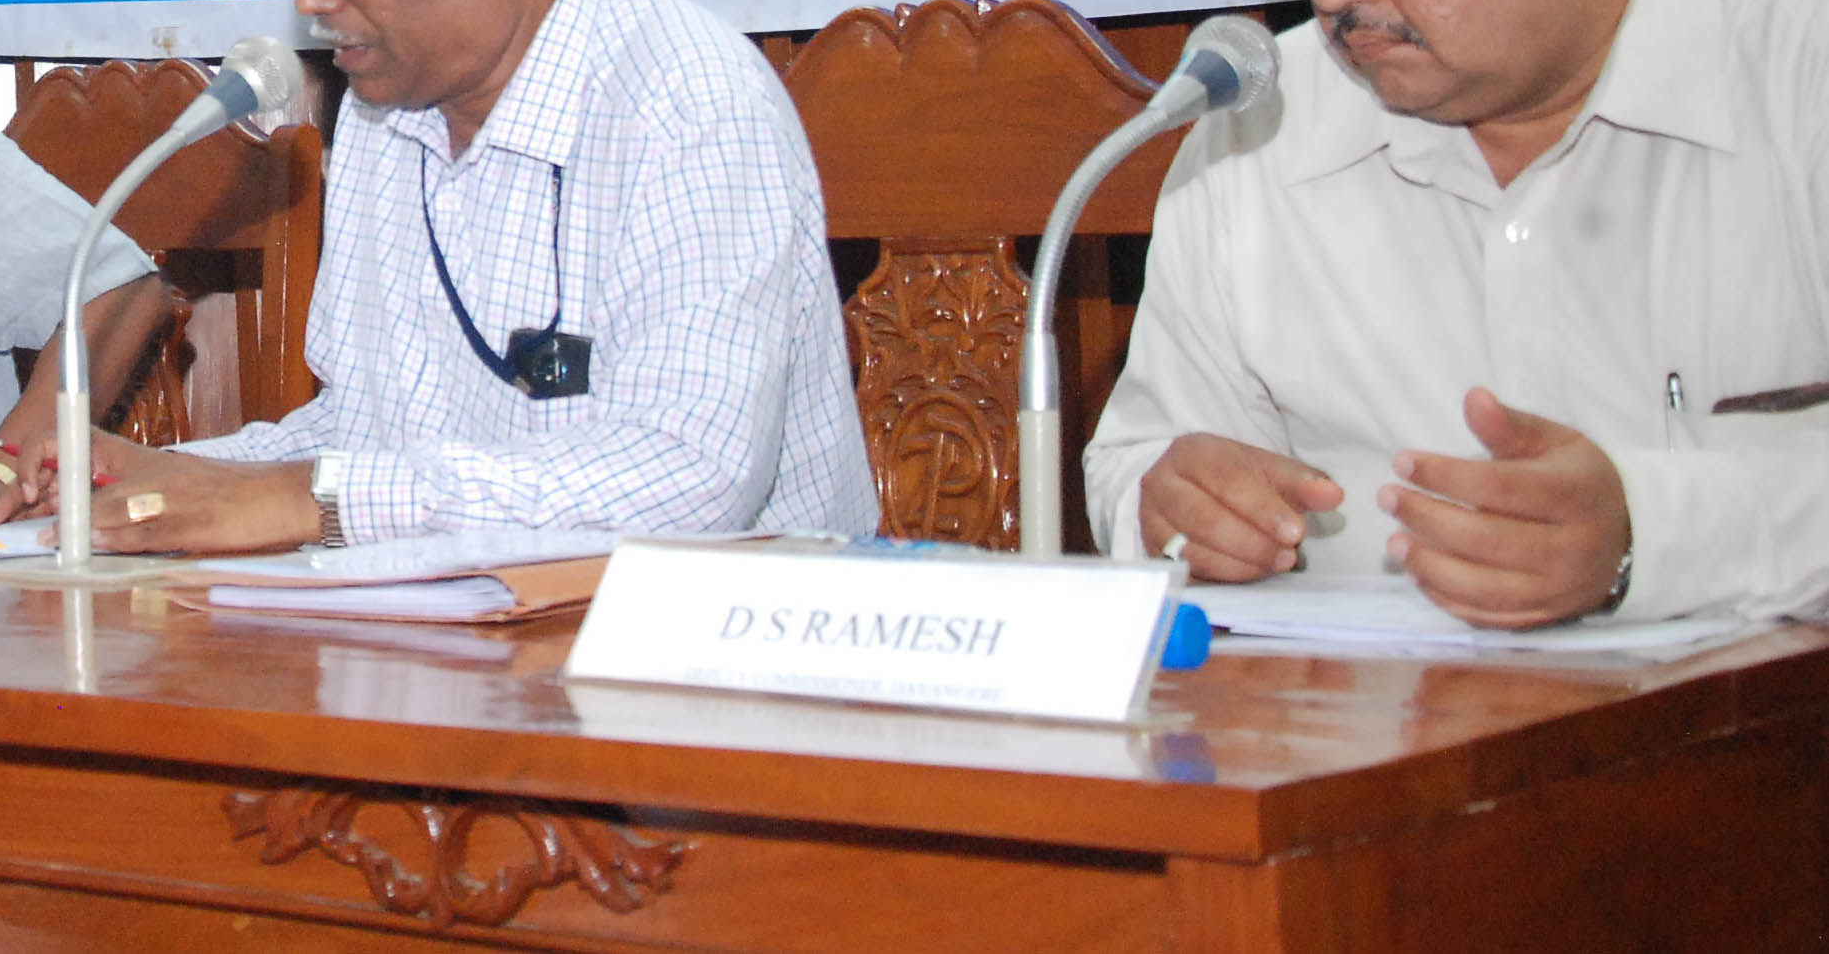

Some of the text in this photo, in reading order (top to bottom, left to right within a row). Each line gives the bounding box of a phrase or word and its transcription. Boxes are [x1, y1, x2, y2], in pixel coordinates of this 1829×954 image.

[720, 606, 1008, 657] D S RAMESH
